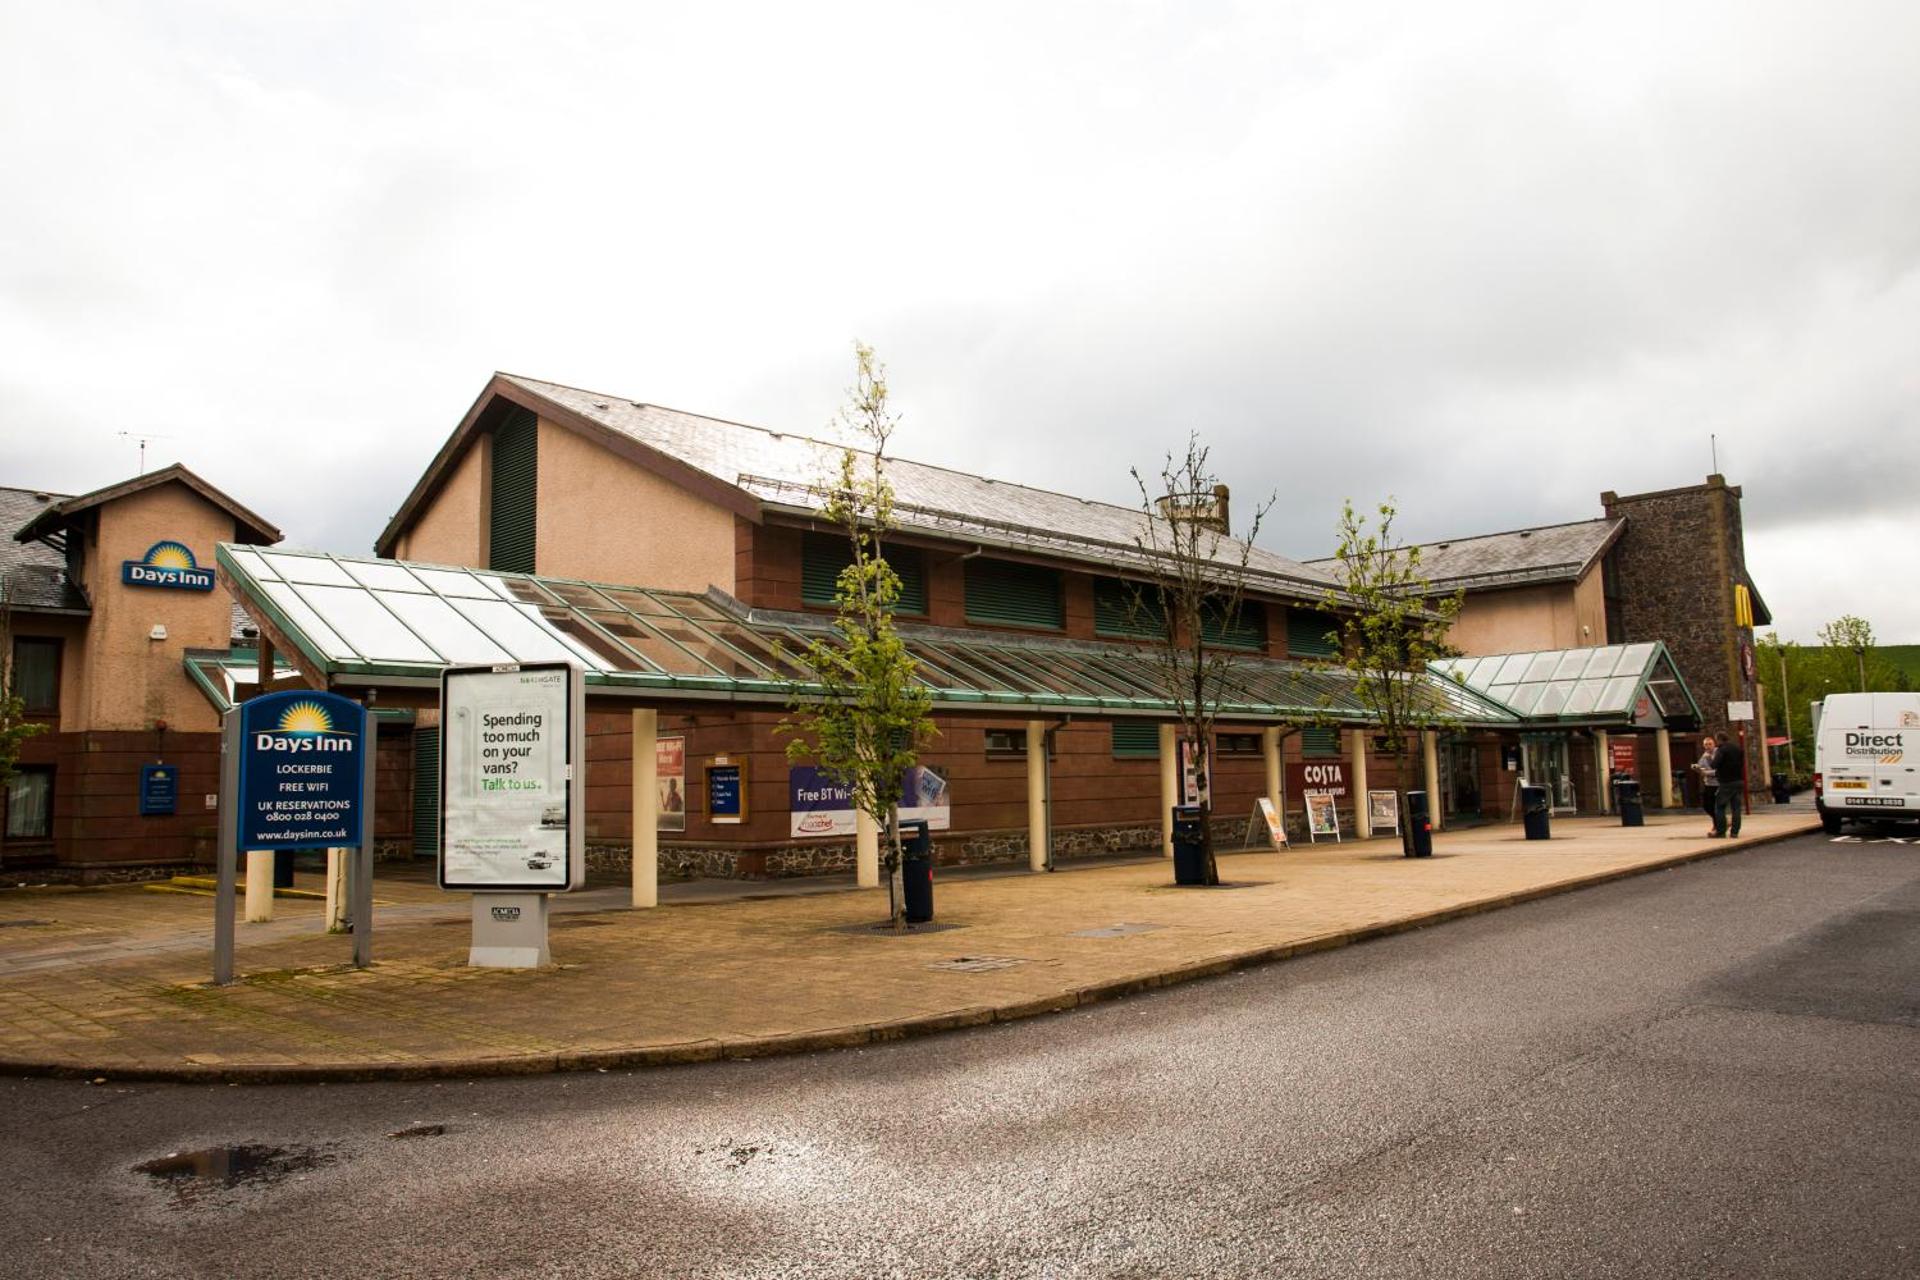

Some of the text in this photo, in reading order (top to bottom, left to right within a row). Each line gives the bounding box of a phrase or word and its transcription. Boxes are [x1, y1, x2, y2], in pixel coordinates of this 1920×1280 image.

[132, 566, 210, 586] Days Inn
[483, 712, 542, 729] Spending
[256, 733, 353, 754] Days Inn
[483, 730, 540, 744] too much
[1845, 732, 1904, 748] Direct
[482, 747, 532, 761] on your
[1845, 747, 1904, 756] Distribution
[276, 764, 334, 774] LOCKERBIE
[483, 762, 519, 774] vans?
[1304, 765, 1343, 785] COSTA
[279, 782, 329, 792] FREE WIFI
[481, 777, 541, 791] Talk to us.
[797, 788, 820, 801] Free
[821, 787, 833, 801] BT
[257, 800, 351, 811] UK RESERVATIONS
[266, 811, 340, 823] 0800 028 0400
[256, 828, 348, 842] www.daysinn.co.uk
